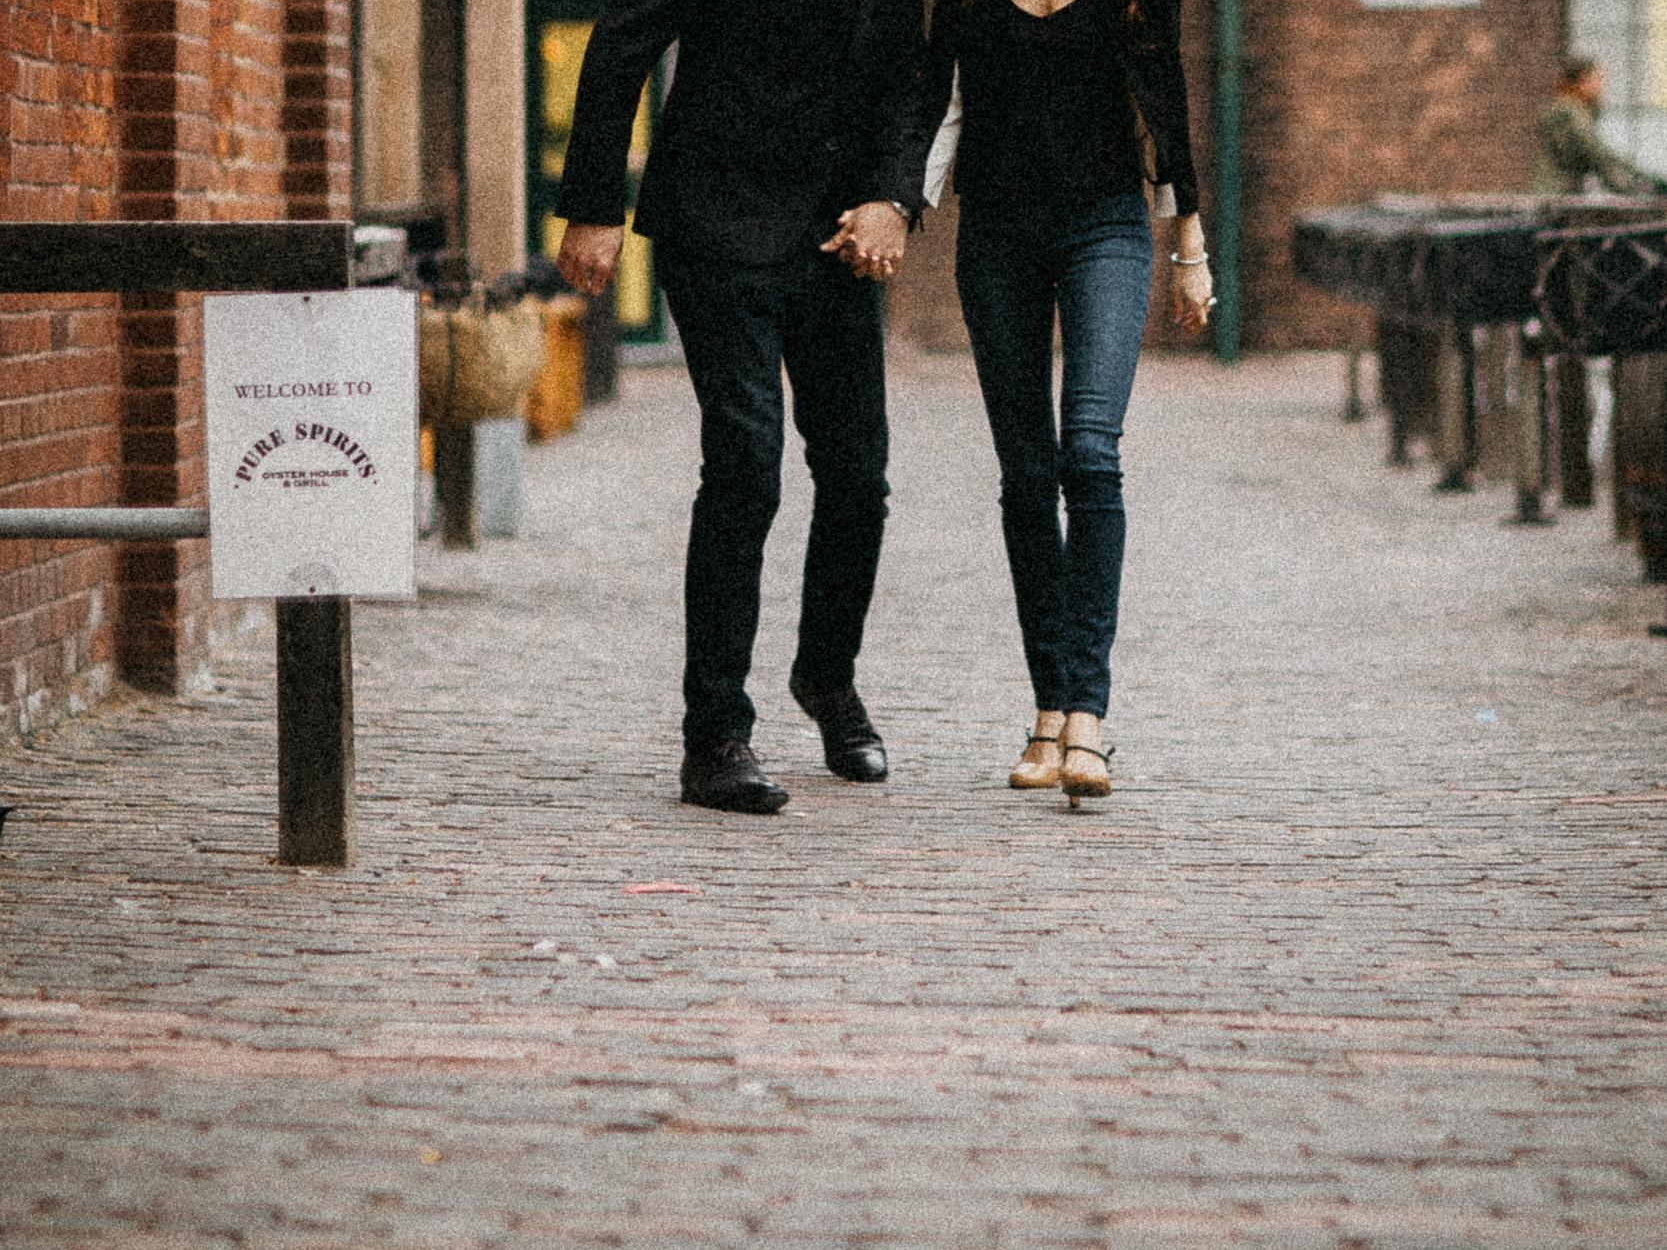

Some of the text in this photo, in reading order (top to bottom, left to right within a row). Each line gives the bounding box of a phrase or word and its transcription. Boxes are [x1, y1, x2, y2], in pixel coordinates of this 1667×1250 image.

[234, 381, 372, 399] WELCOME TO
[235, 423, 377, 483] PURE SPIRITS
[261, 469, 349, 480] OYSTER HOUSE
[293, 479, 330, 488] GRILL
